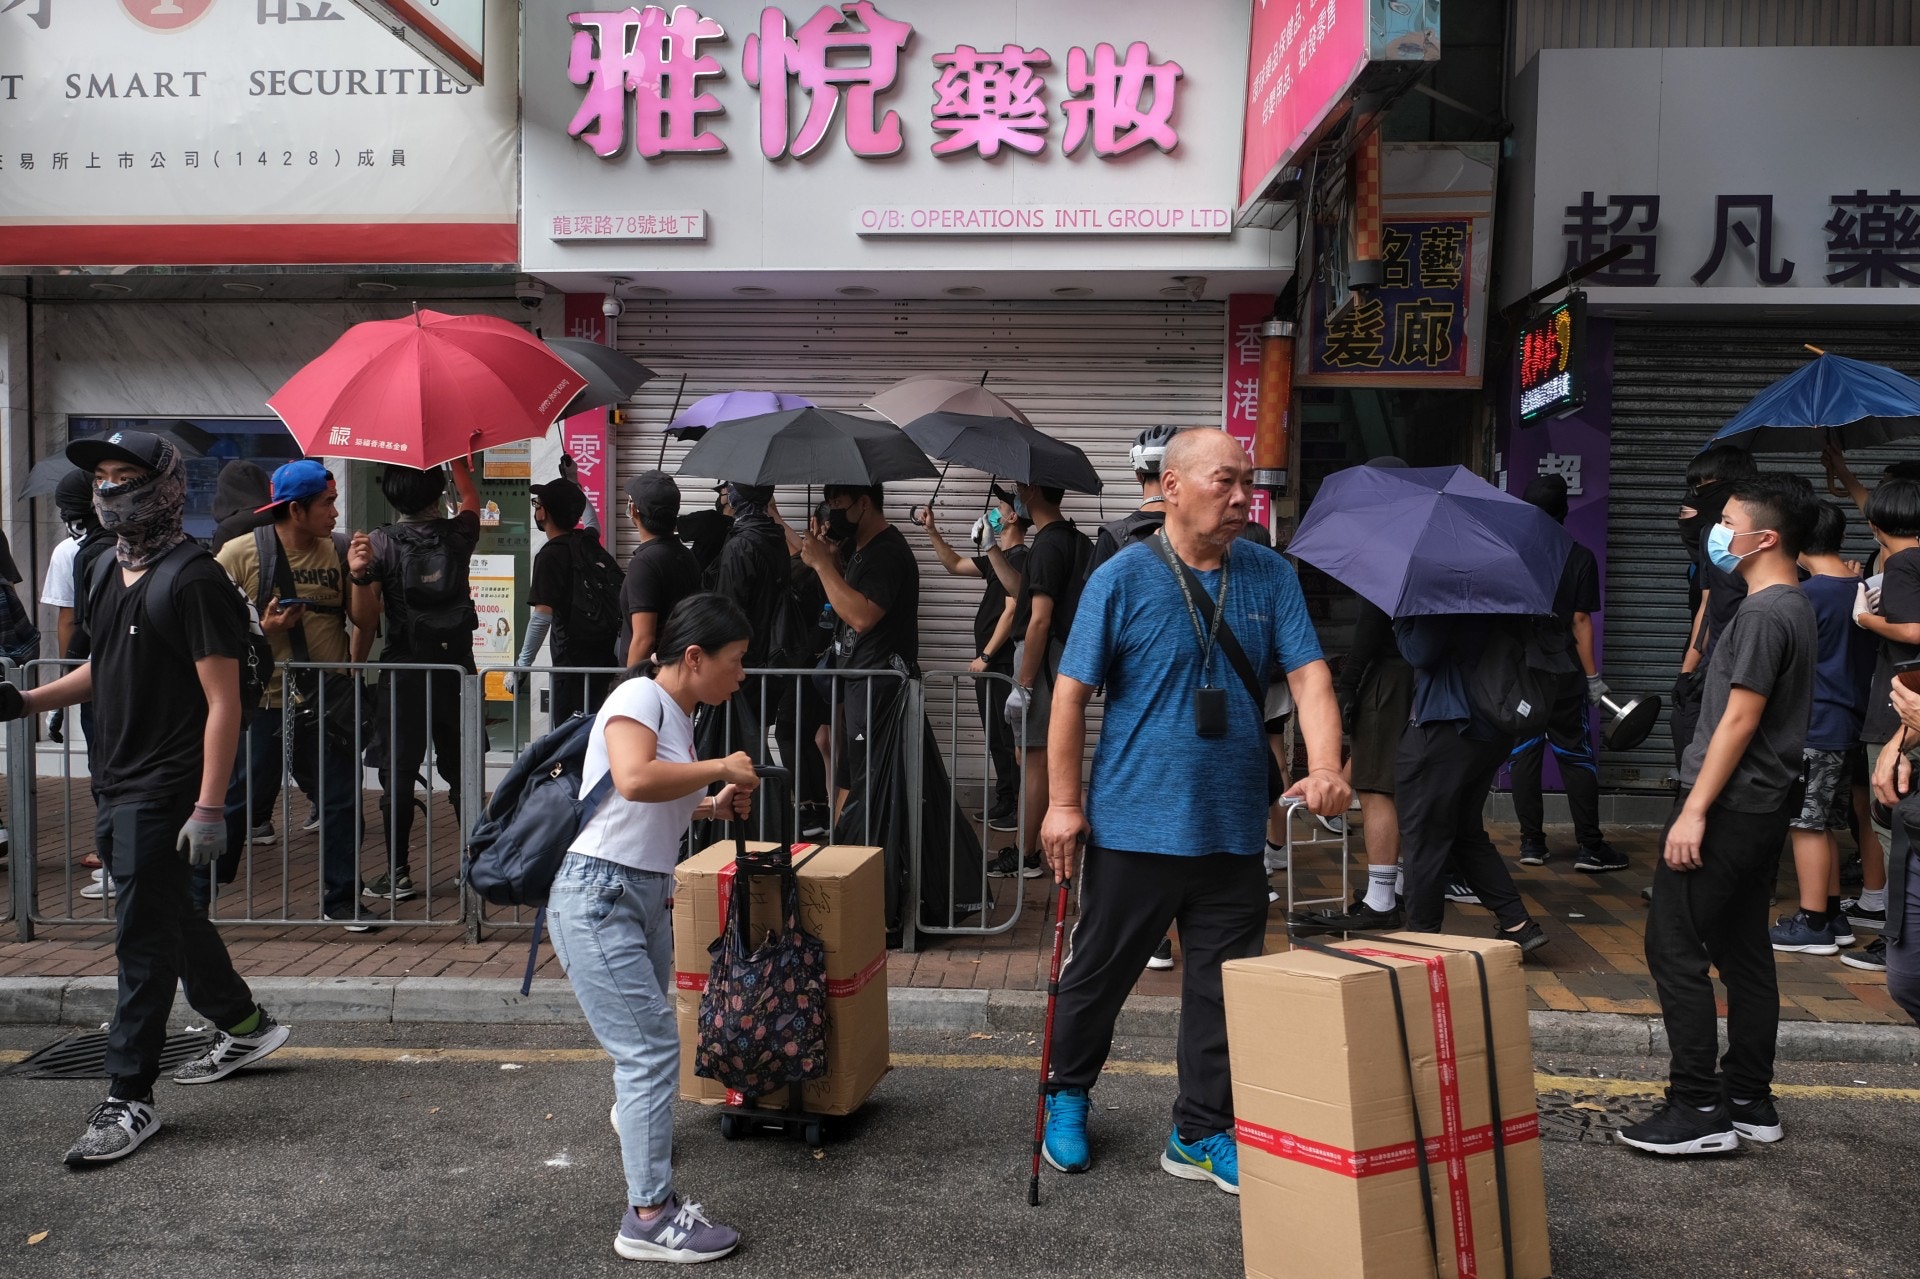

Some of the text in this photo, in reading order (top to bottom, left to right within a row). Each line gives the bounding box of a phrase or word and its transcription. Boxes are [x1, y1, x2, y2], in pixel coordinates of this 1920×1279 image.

[65, 71, 207, 99] SMART
[0, 150, 406, 170] 易所上市公司(1428)成員
[552, 214, 699, 235] 龍琛路78號地下
[861, 208, 1230, 231] O/B: OPERATIONS INTL GROUP LTD
